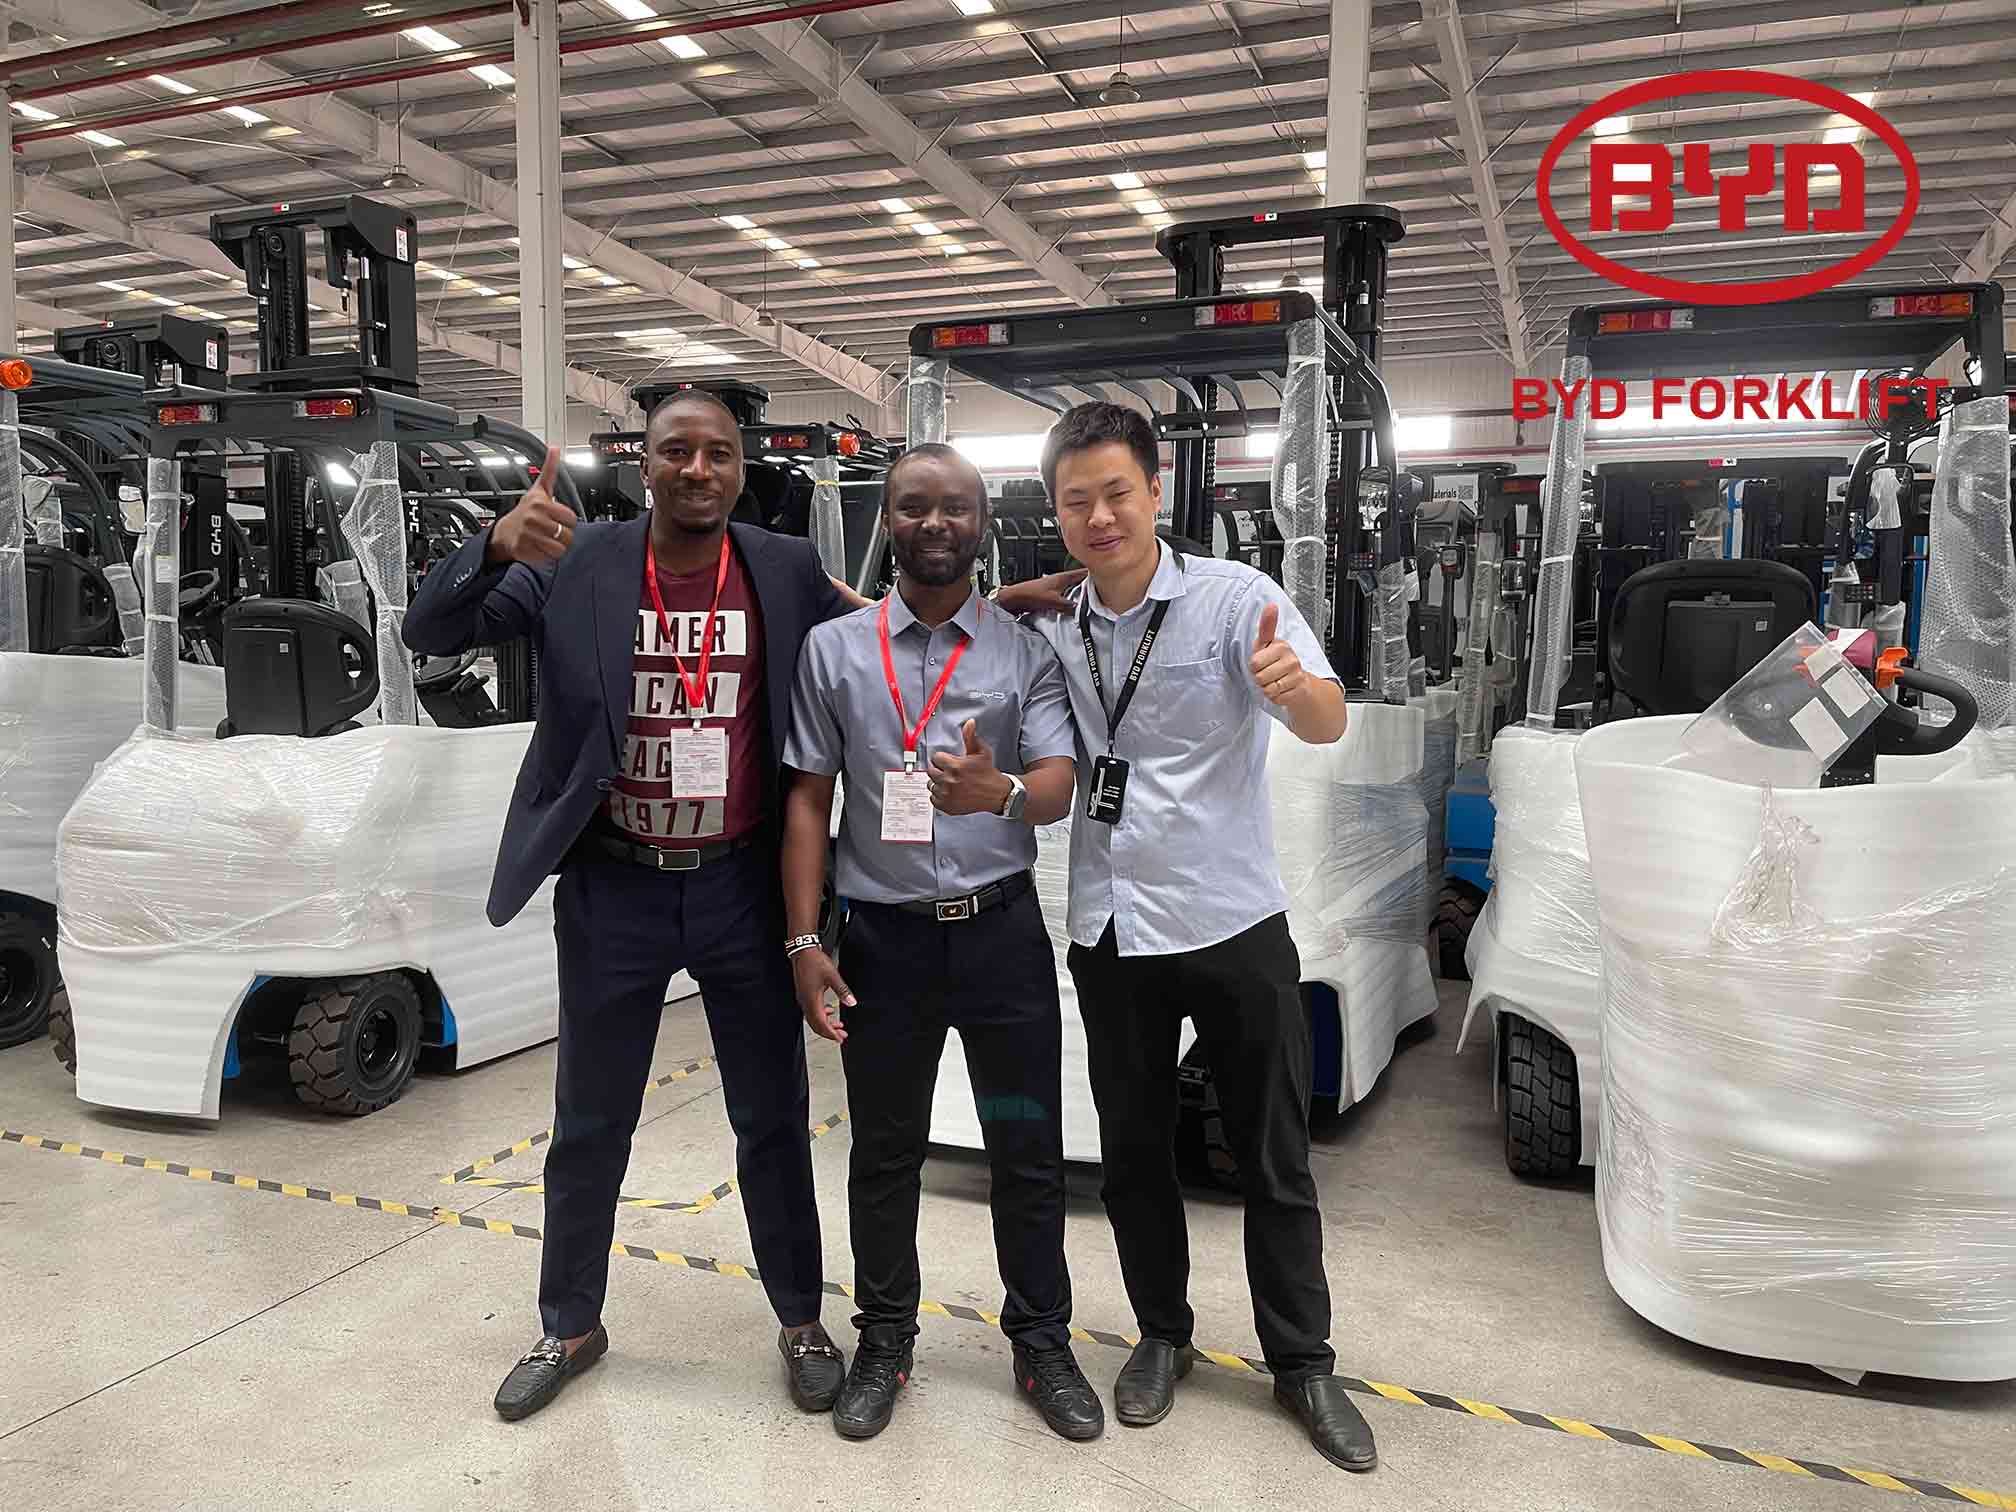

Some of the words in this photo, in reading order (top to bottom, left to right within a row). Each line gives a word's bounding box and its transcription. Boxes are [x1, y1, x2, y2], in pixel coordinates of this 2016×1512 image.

[1433, 488, 1457, 498] aterials
[211, 514, 222, 556] BYD
[1129, 665, 1141, 682] BYD
[1136, 629, 1155, 666] FORKLIFT
